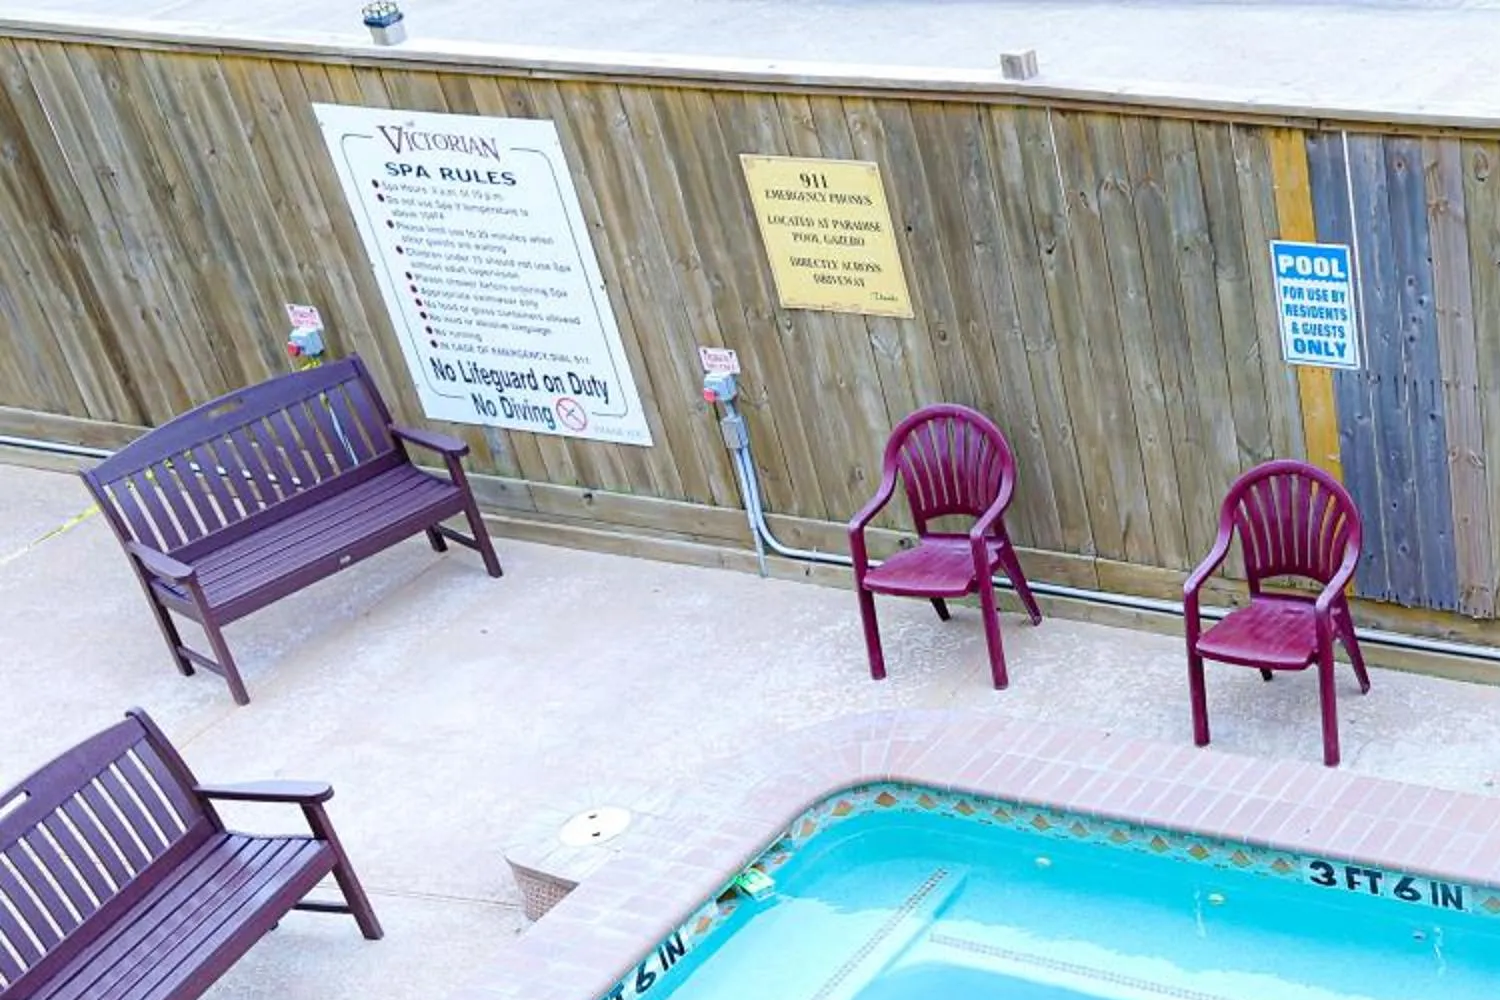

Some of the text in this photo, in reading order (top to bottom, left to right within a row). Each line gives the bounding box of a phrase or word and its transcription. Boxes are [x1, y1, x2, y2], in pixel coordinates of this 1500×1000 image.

[384, 162, 517, 186] SPA RULES
[800, 173, 828, 189] 911
[1277, 254, 1346, 278] POOL
[1283, 286, 1345, 304] FOR USE BY
[1285, 304, 1347, 321] RESIDENTS
[1292, 322, 1345, 339] & GUESTS
[1294, 338, 1346, 358] ONLY
[430, 356, 609, 404] No Lifeguard on Duty
[470, 393, 556, 430] No Diving
[1309, 860, 1337, 886] 3
[1394, 876, 1422, 902] 6
[635, 960, 656, 994] 6
